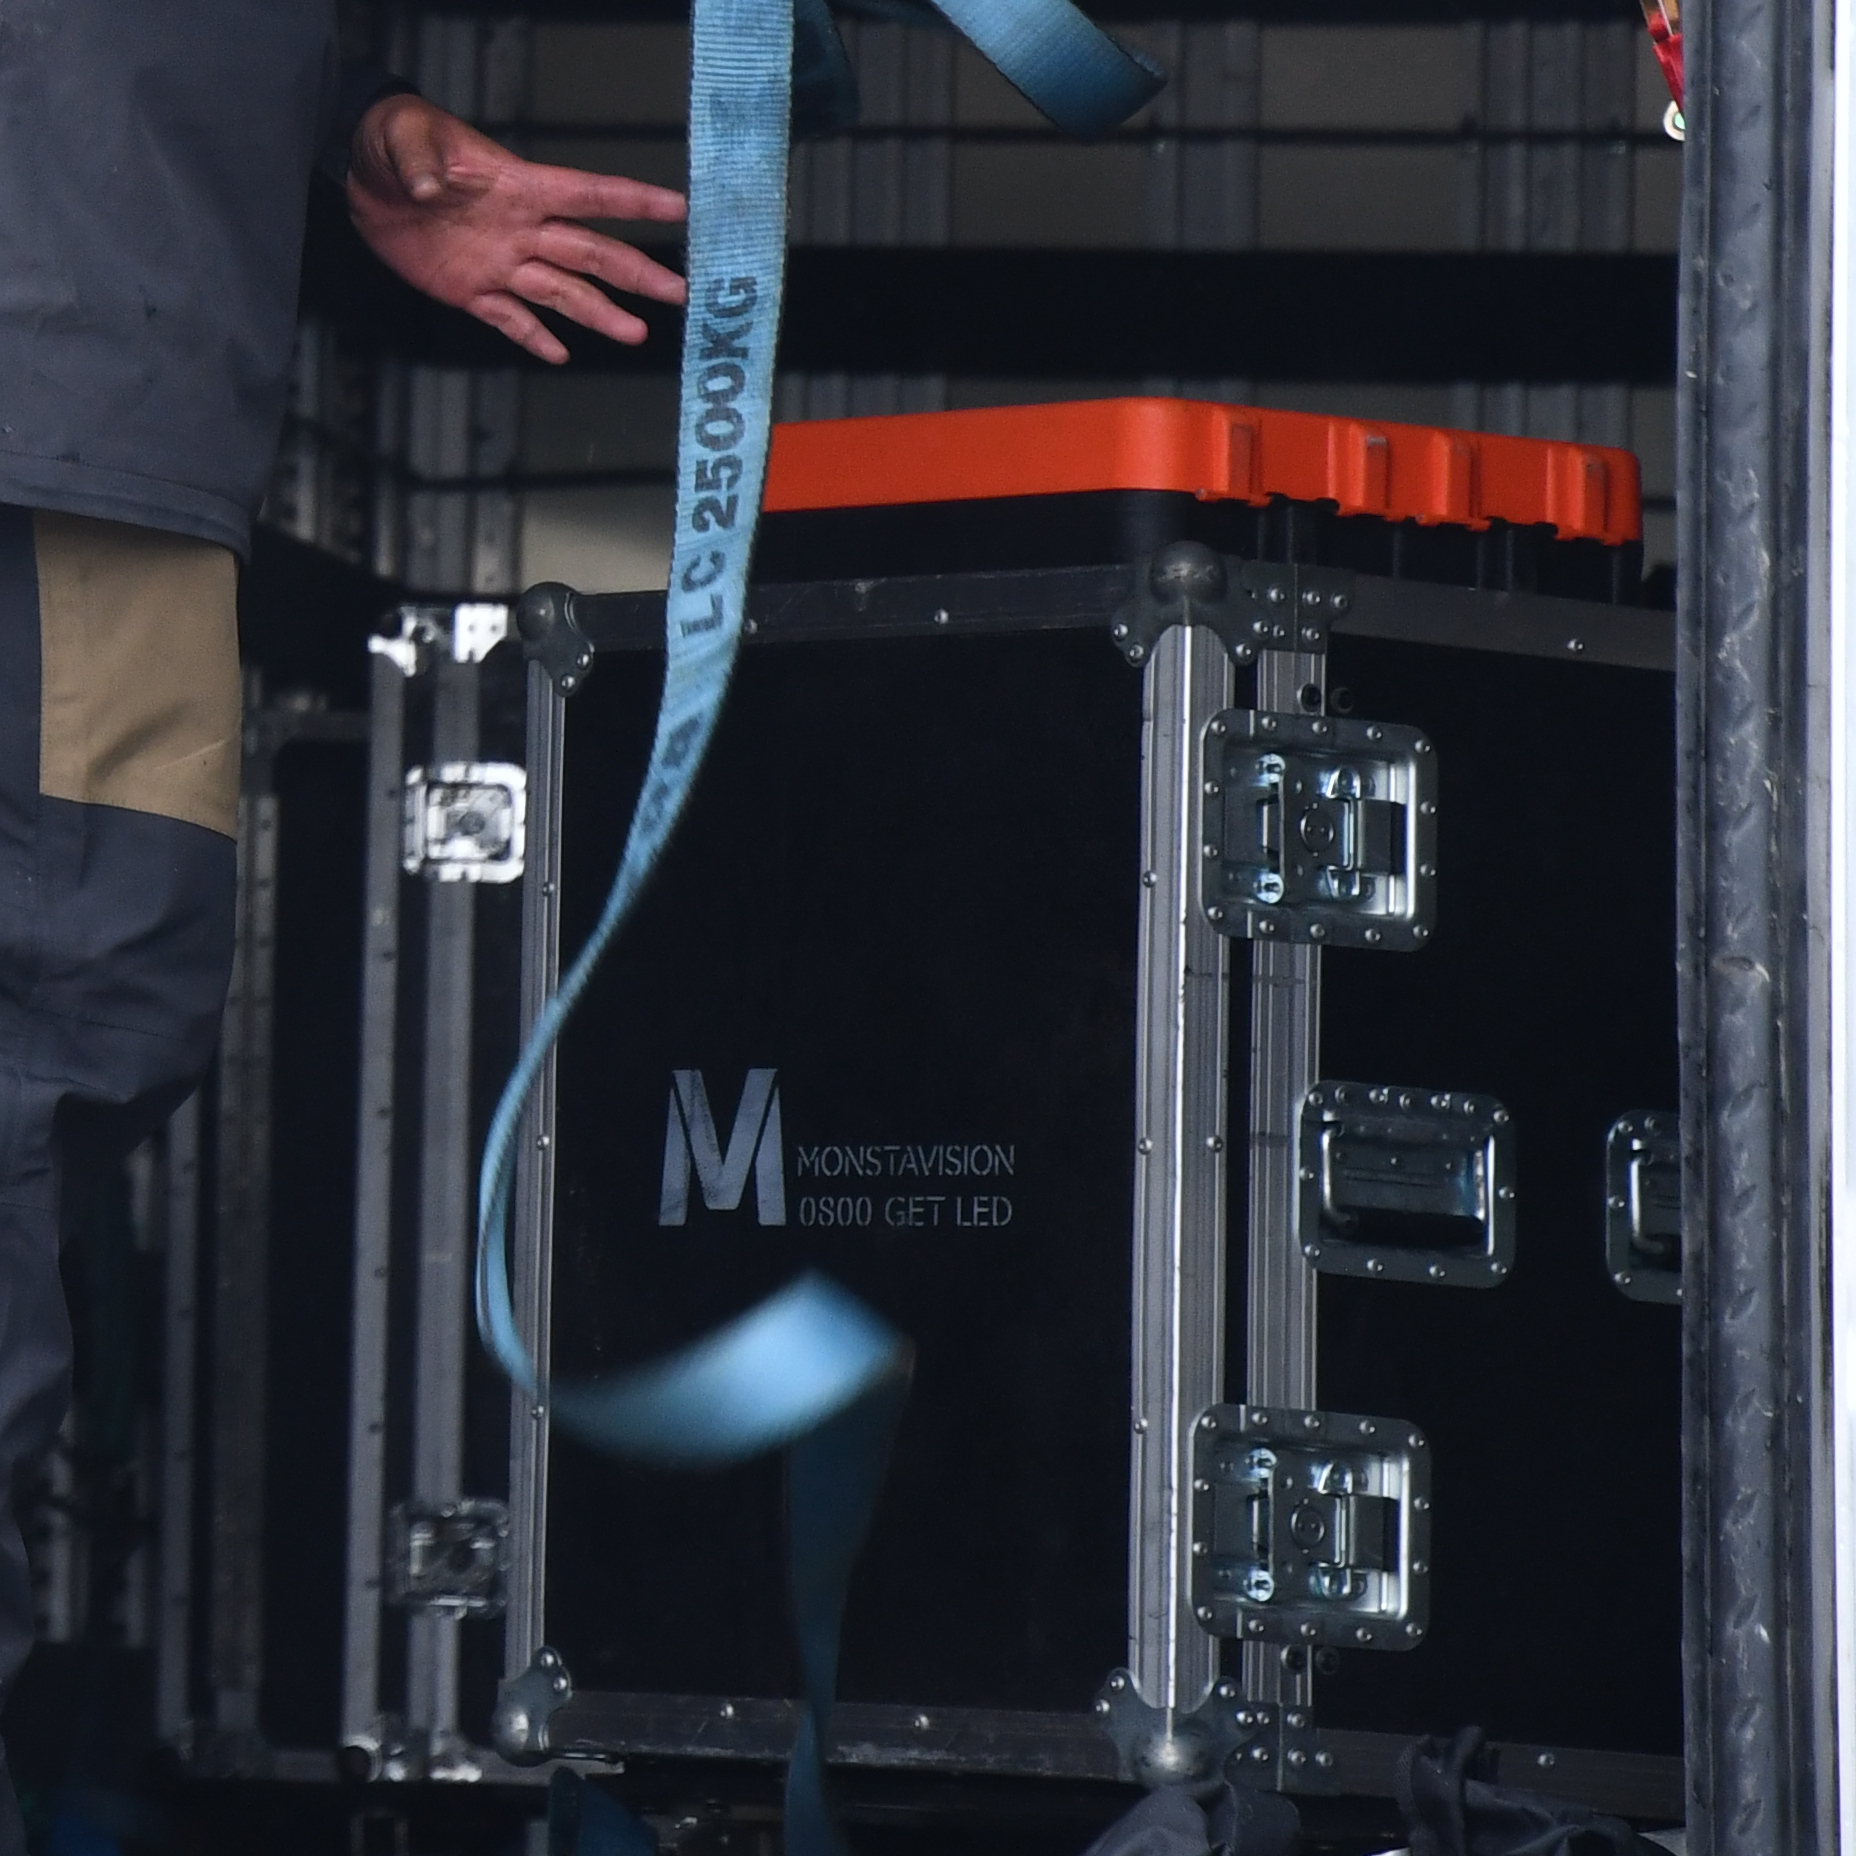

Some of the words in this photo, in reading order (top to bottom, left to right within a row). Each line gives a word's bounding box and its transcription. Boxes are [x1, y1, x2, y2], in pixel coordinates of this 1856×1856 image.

[691, 275, 759, 534] 2500KG
[679, 548, 726, 639] LC
[658, 1067, 787, 1227] M
[797, 1144, 1015, 1177] MONSTAVISION
[798, 1196, 873, 1227] 0800
[884, 1196, 946, 1227] GET
[956, 1196, 1014, 1227] LED
